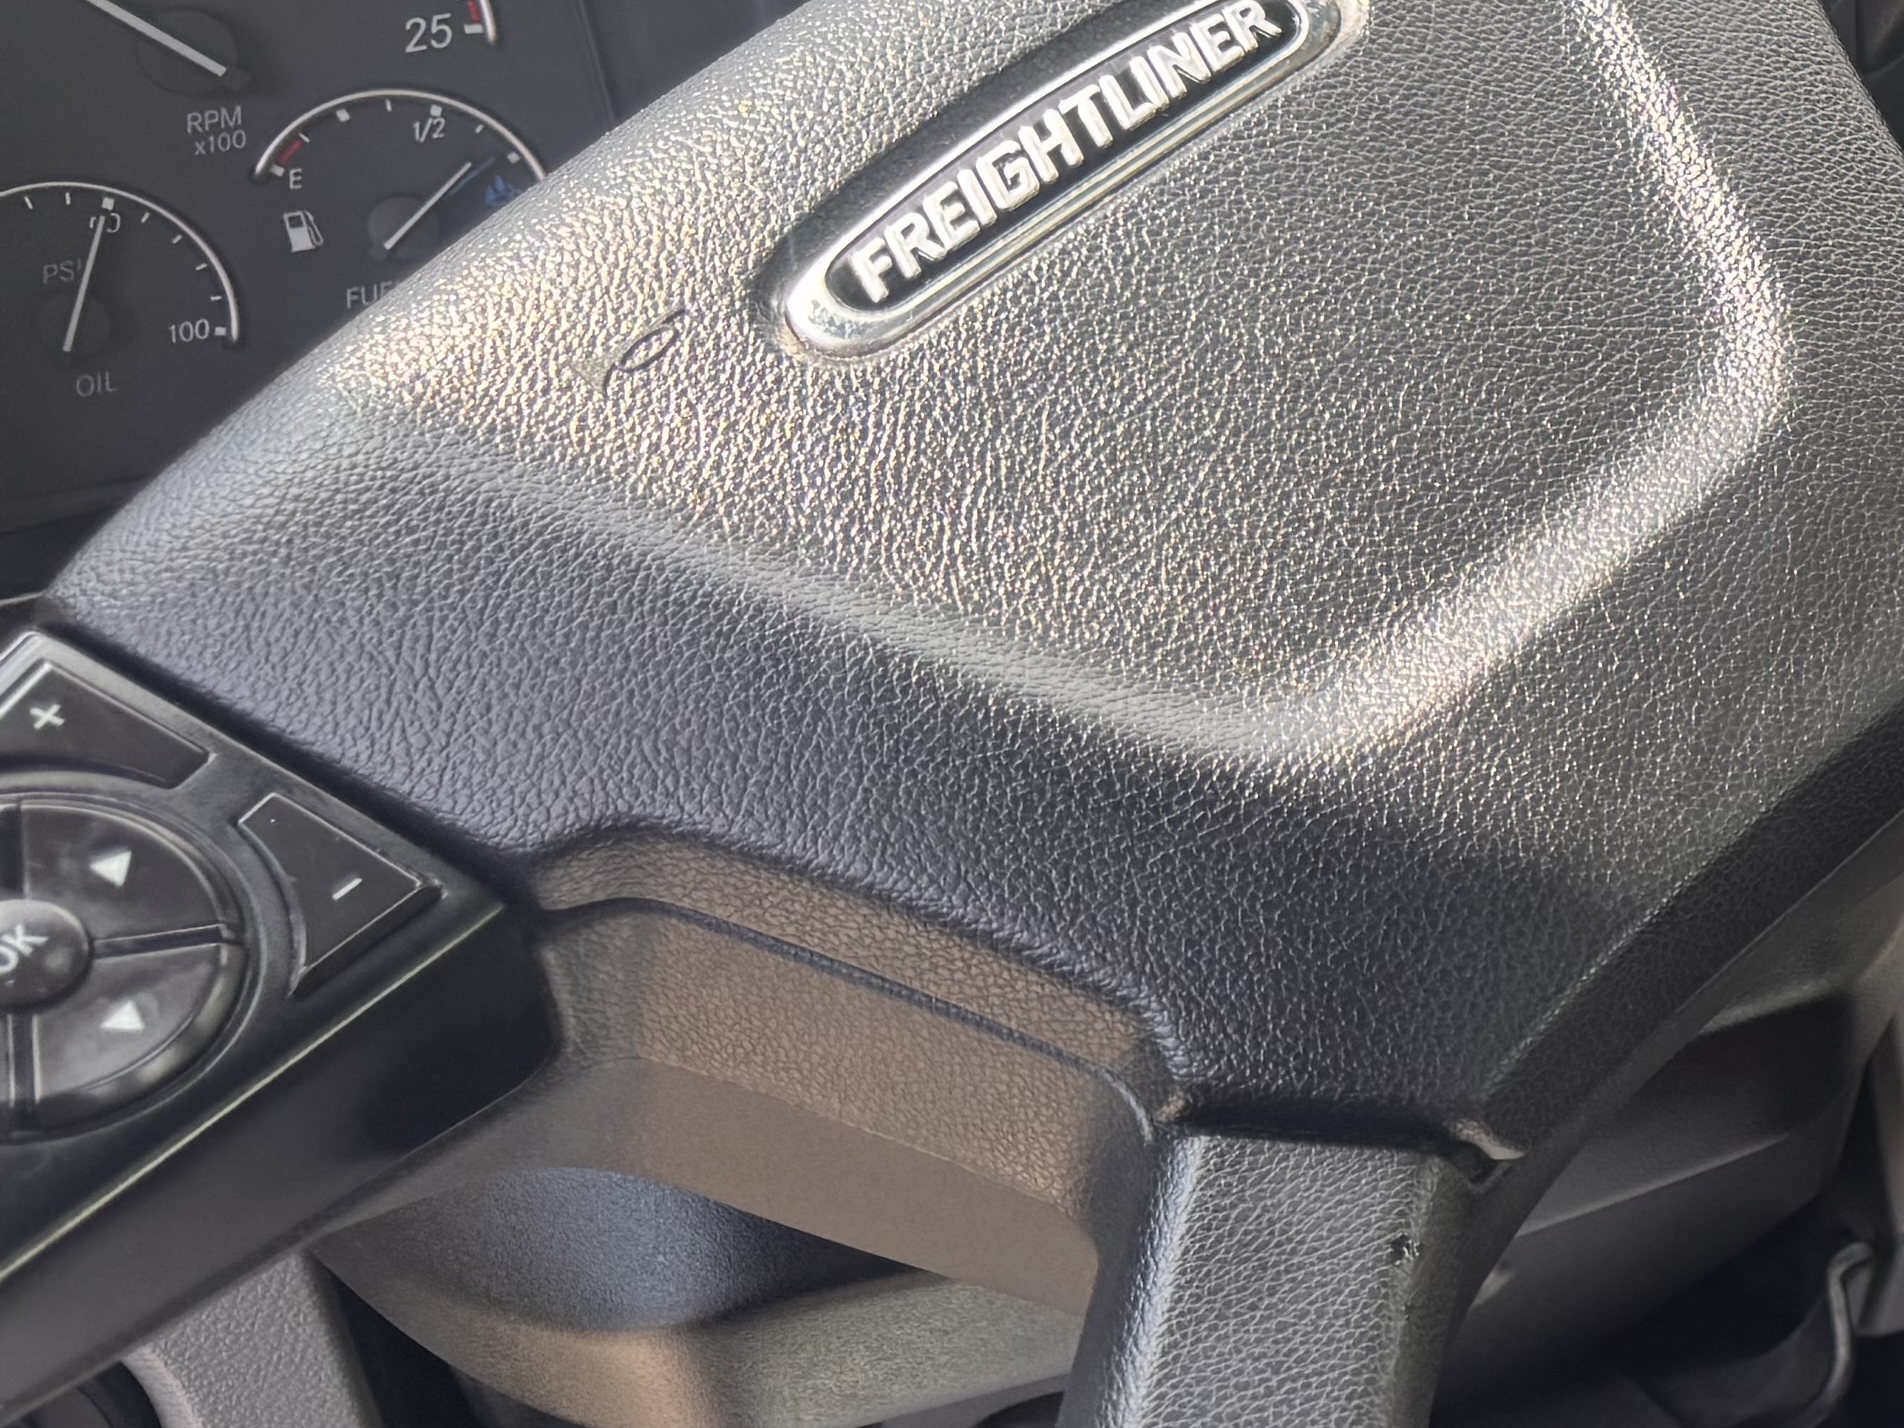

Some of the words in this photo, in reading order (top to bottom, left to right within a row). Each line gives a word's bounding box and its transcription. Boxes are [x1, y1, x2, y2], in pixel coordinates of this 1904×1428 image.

[404, 13, 453, 53] 25
[186, 105, 243, 134] RPM
[413, 118, 447, 143] 1/2
[193, 130, 247, 156] x100
[289, 168, 303, 190] E
[169, 318, 211, 344] 100
[76, 371, 119, 398] OIL
